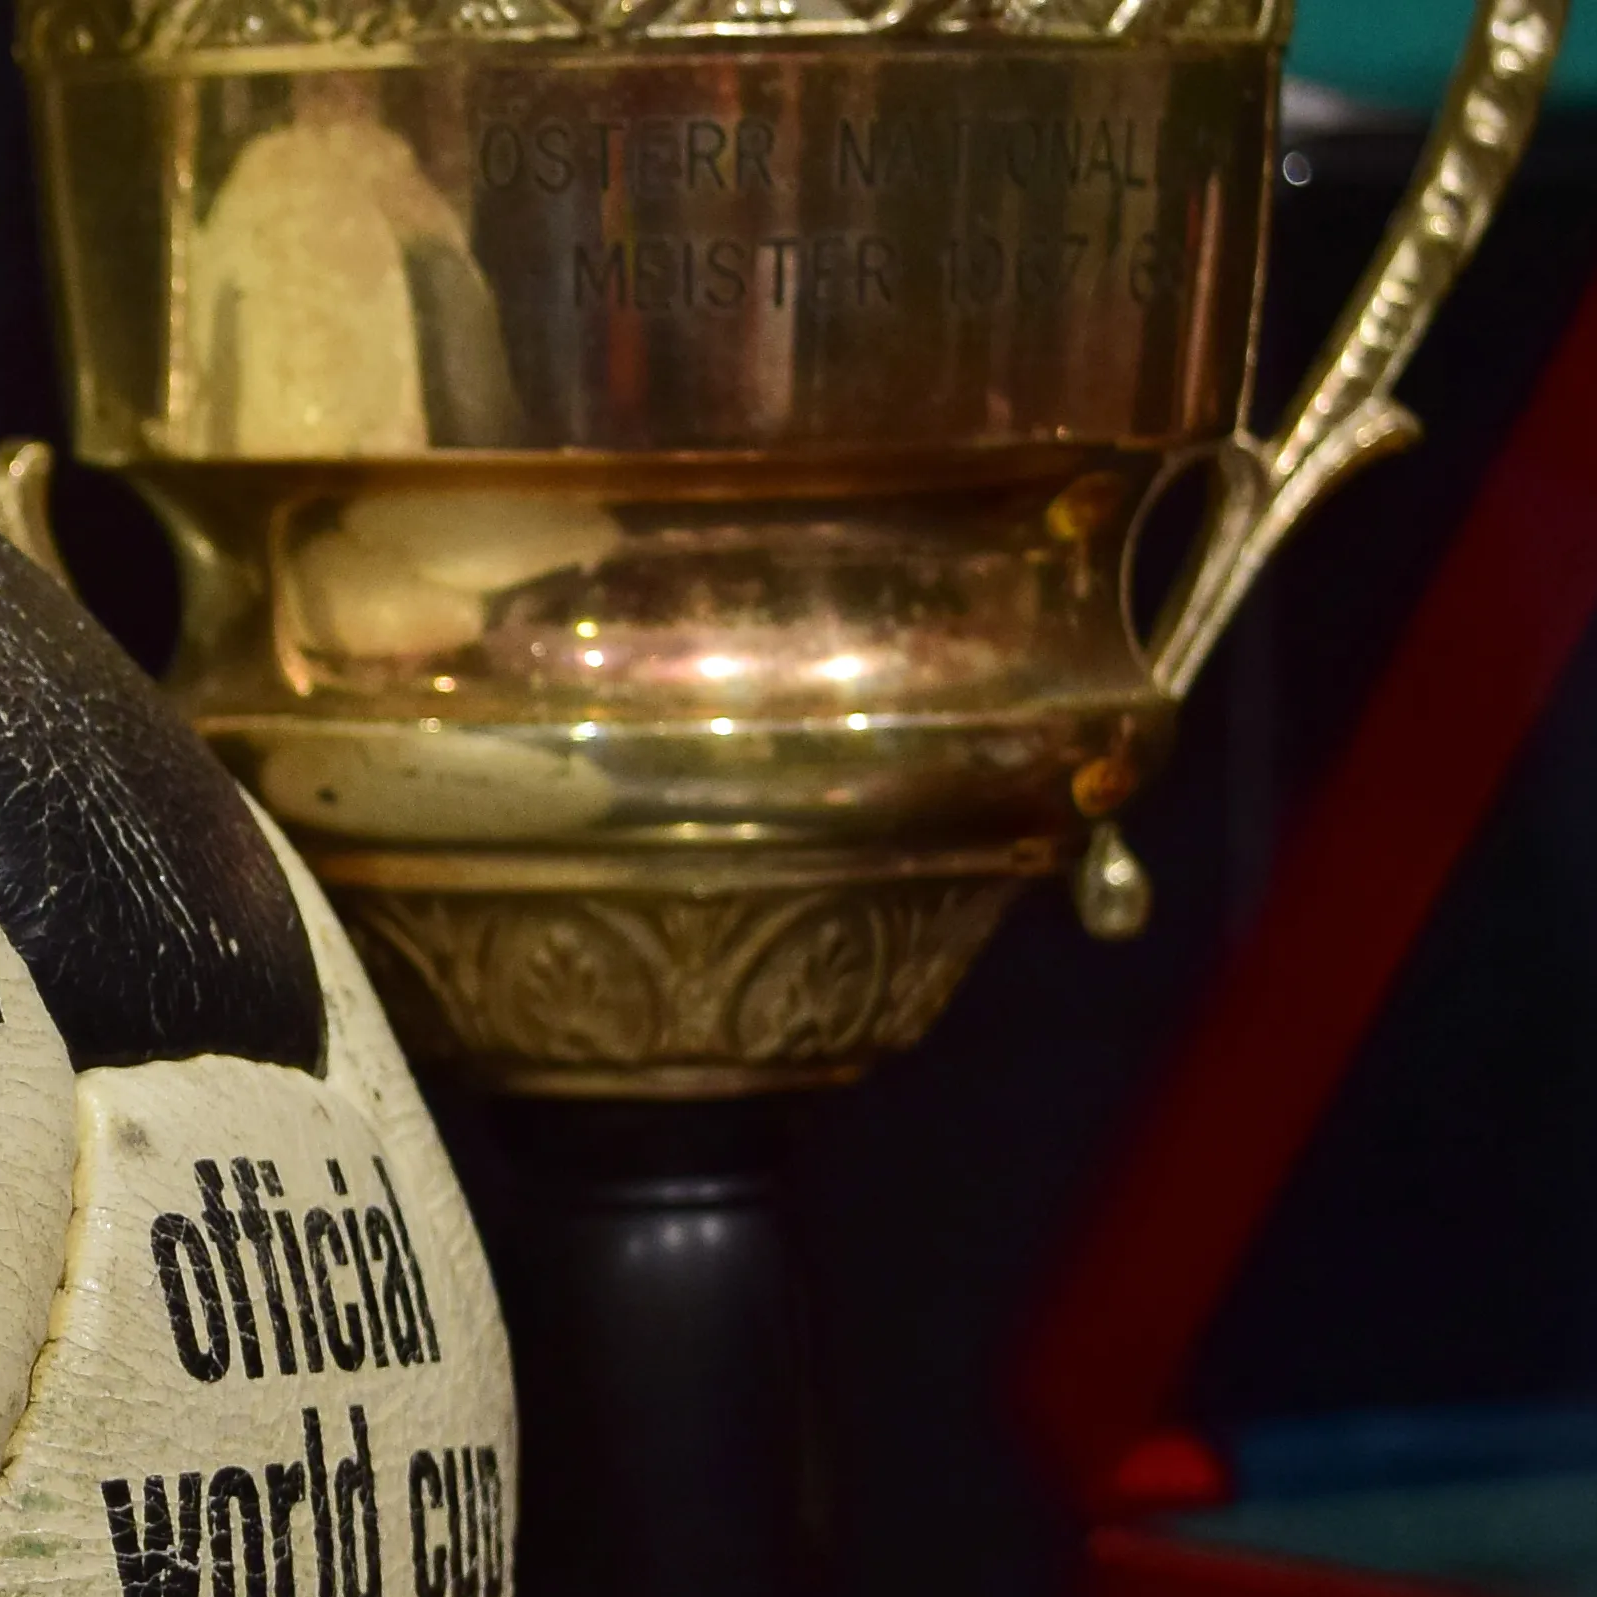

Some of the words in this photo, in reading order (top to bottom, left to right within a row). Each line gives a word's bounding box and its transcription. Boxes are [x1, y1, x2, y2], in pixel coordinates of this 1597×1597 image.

[839, 114, 1147, 190] NATONAL
[572, 236, 894, 312] MEISTER
[150, 1156, 441, 1383] official
